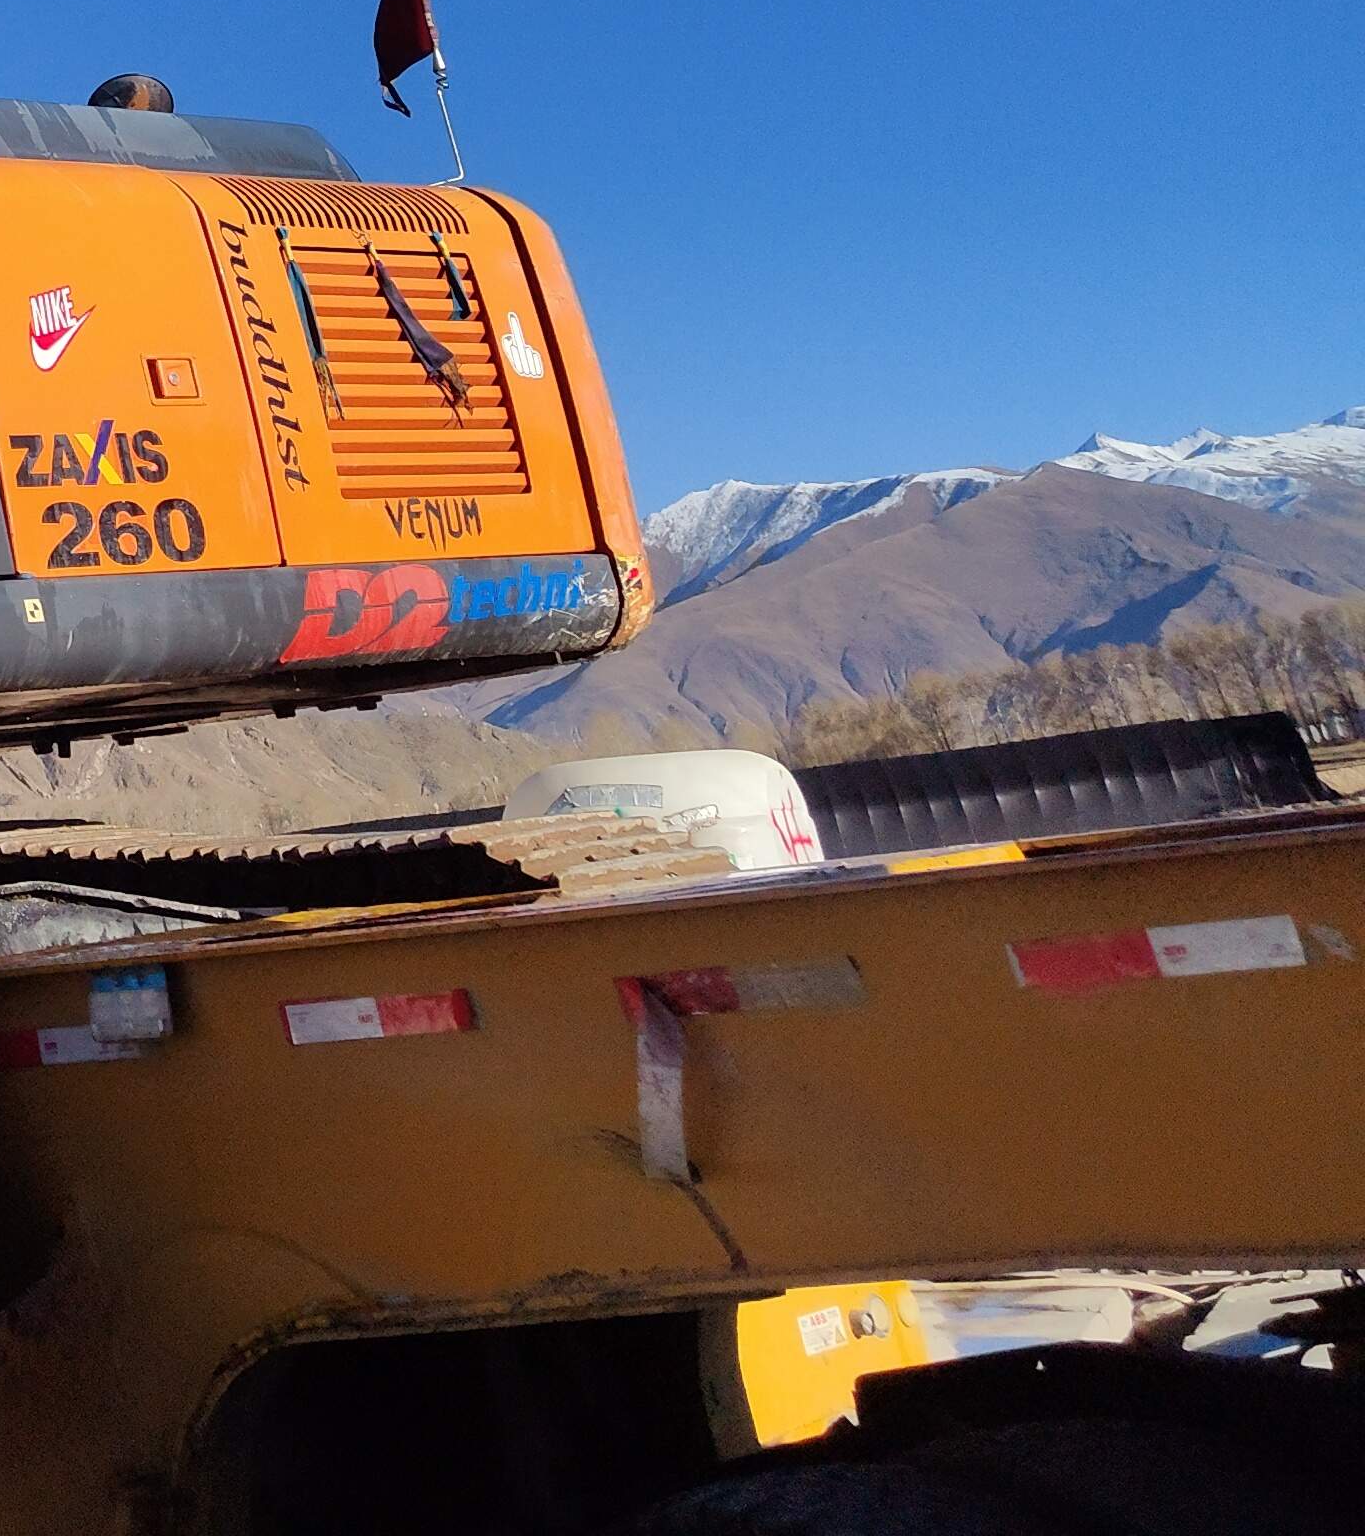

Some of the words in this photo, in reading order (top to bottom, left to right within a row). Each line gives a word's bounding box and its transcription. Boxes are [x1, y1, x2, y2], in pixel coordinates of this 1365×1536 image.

[30, 286, 77, 336] NIKE
[9, 419, 169, 487] ZAXIS
[41, 499, 207, 569] 260
[384, 497, 482, 552] VENUM
